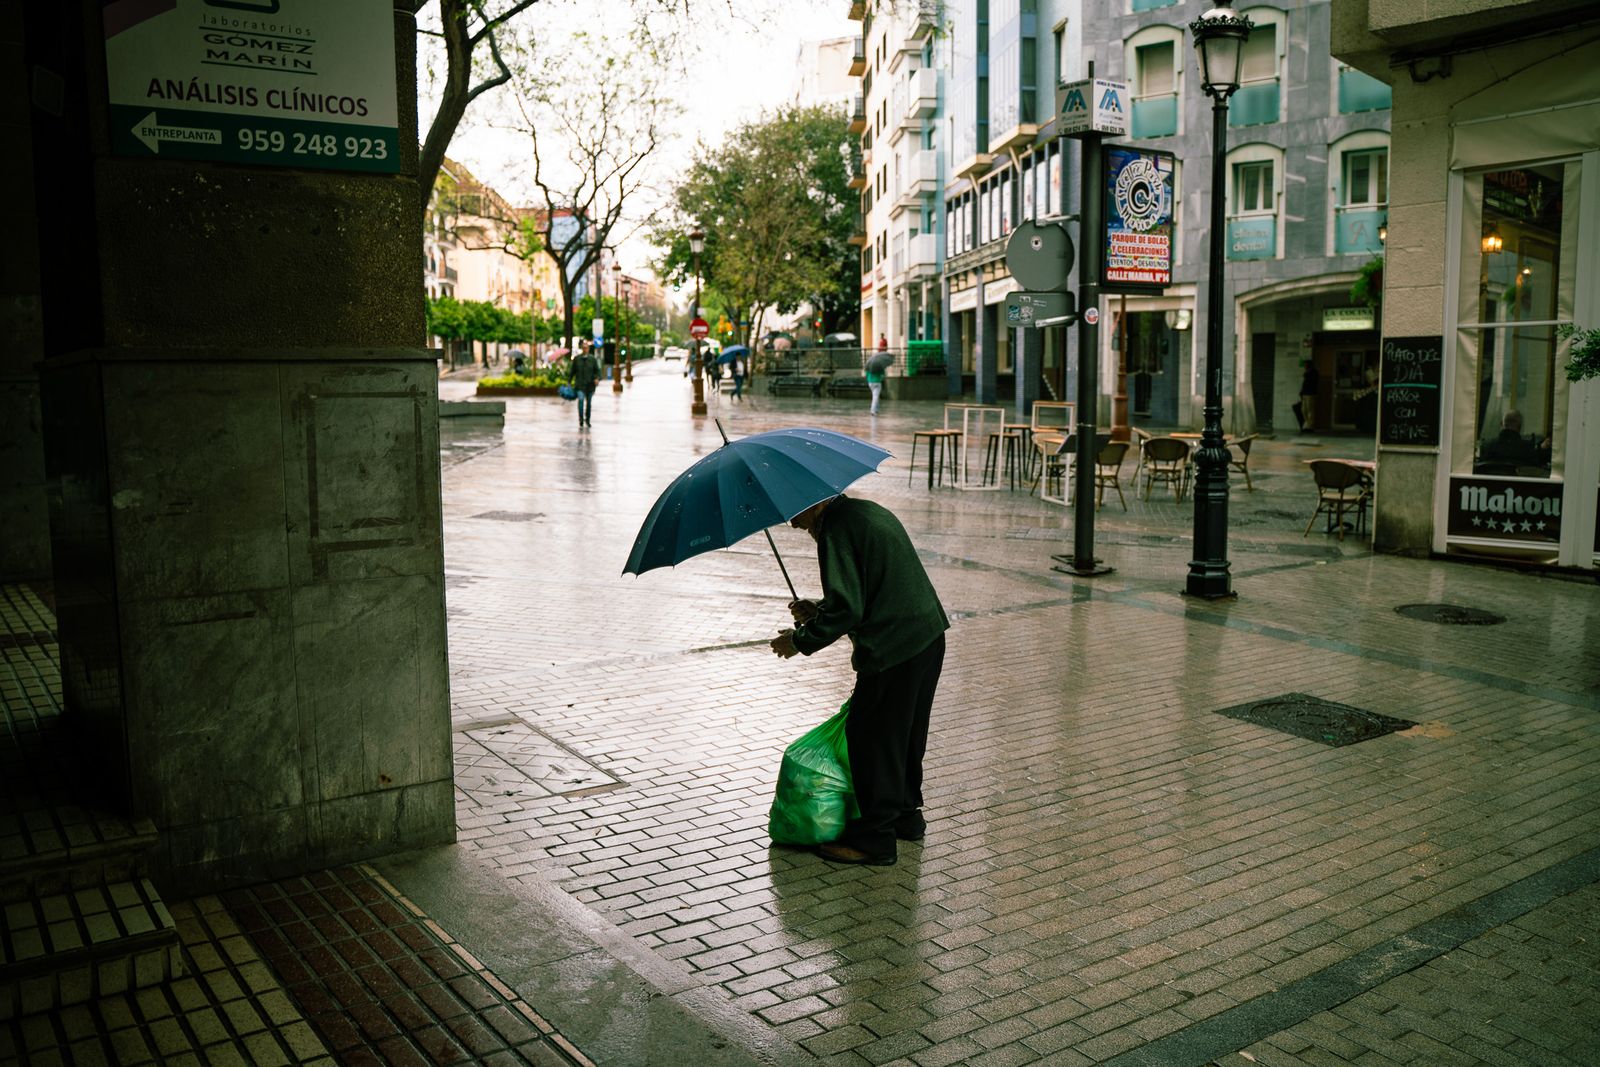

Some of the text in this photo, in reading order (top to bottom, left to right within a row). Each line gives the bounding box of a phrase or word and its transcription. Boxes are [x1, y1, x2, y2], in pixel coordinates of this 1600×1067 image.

[202, 14, 312, 36] laboratorios
[204, 34, 313, 54] GÓMEZ
[206, 49, 312, 69] MARÍN
[147, 77, 368, 117] ANÁLISIS CLÍNICOS
[141, 127, 388, 159] ENTREPLANTA 959 248 923
[1112, 234, 1137, 243] PARQUE
[1148, 236, 1168, 244] BOLAS
[1117, 246, 1167, 255] CELEBRACIONES
[1108, 270, 1128, 280] CALLE
[1394, 407, 1416, 418] CON
[1460, 486, 1560, 516] Mahou
